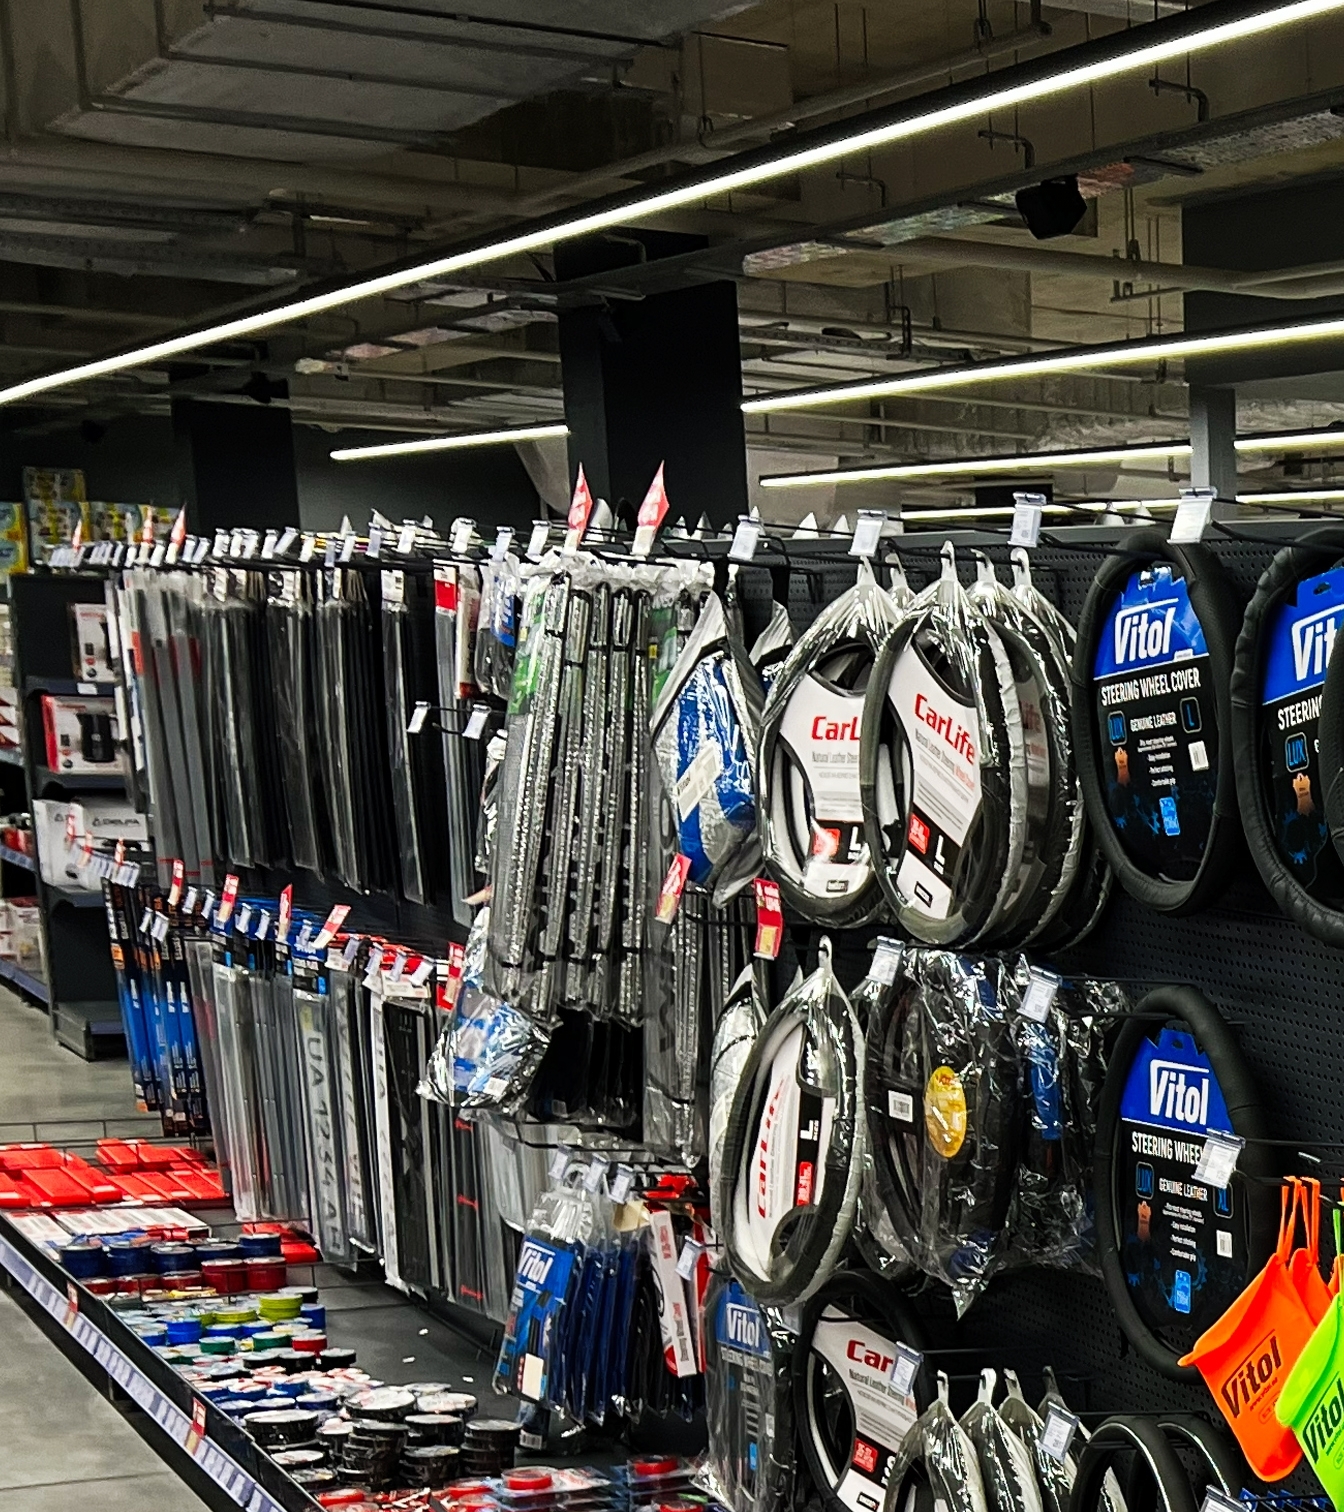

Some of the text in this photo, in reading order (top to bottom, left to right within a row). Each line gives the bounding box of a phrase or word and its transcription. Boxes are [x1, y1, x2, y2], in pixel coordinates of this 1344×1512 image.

[1115, 598, 1179, 664] Vitol
[1101, 667, 1201, 707] STEERING WHEEL COVER
[914, 693, 976, 765] CarLife
[1148, 1058, 1210, 1125] Vitol
[519, 1246, 552, 1283] Vitol
[726, 1303, 761, 1348] Vitol
[1221, 1328, 1282, 1419] Vitol
